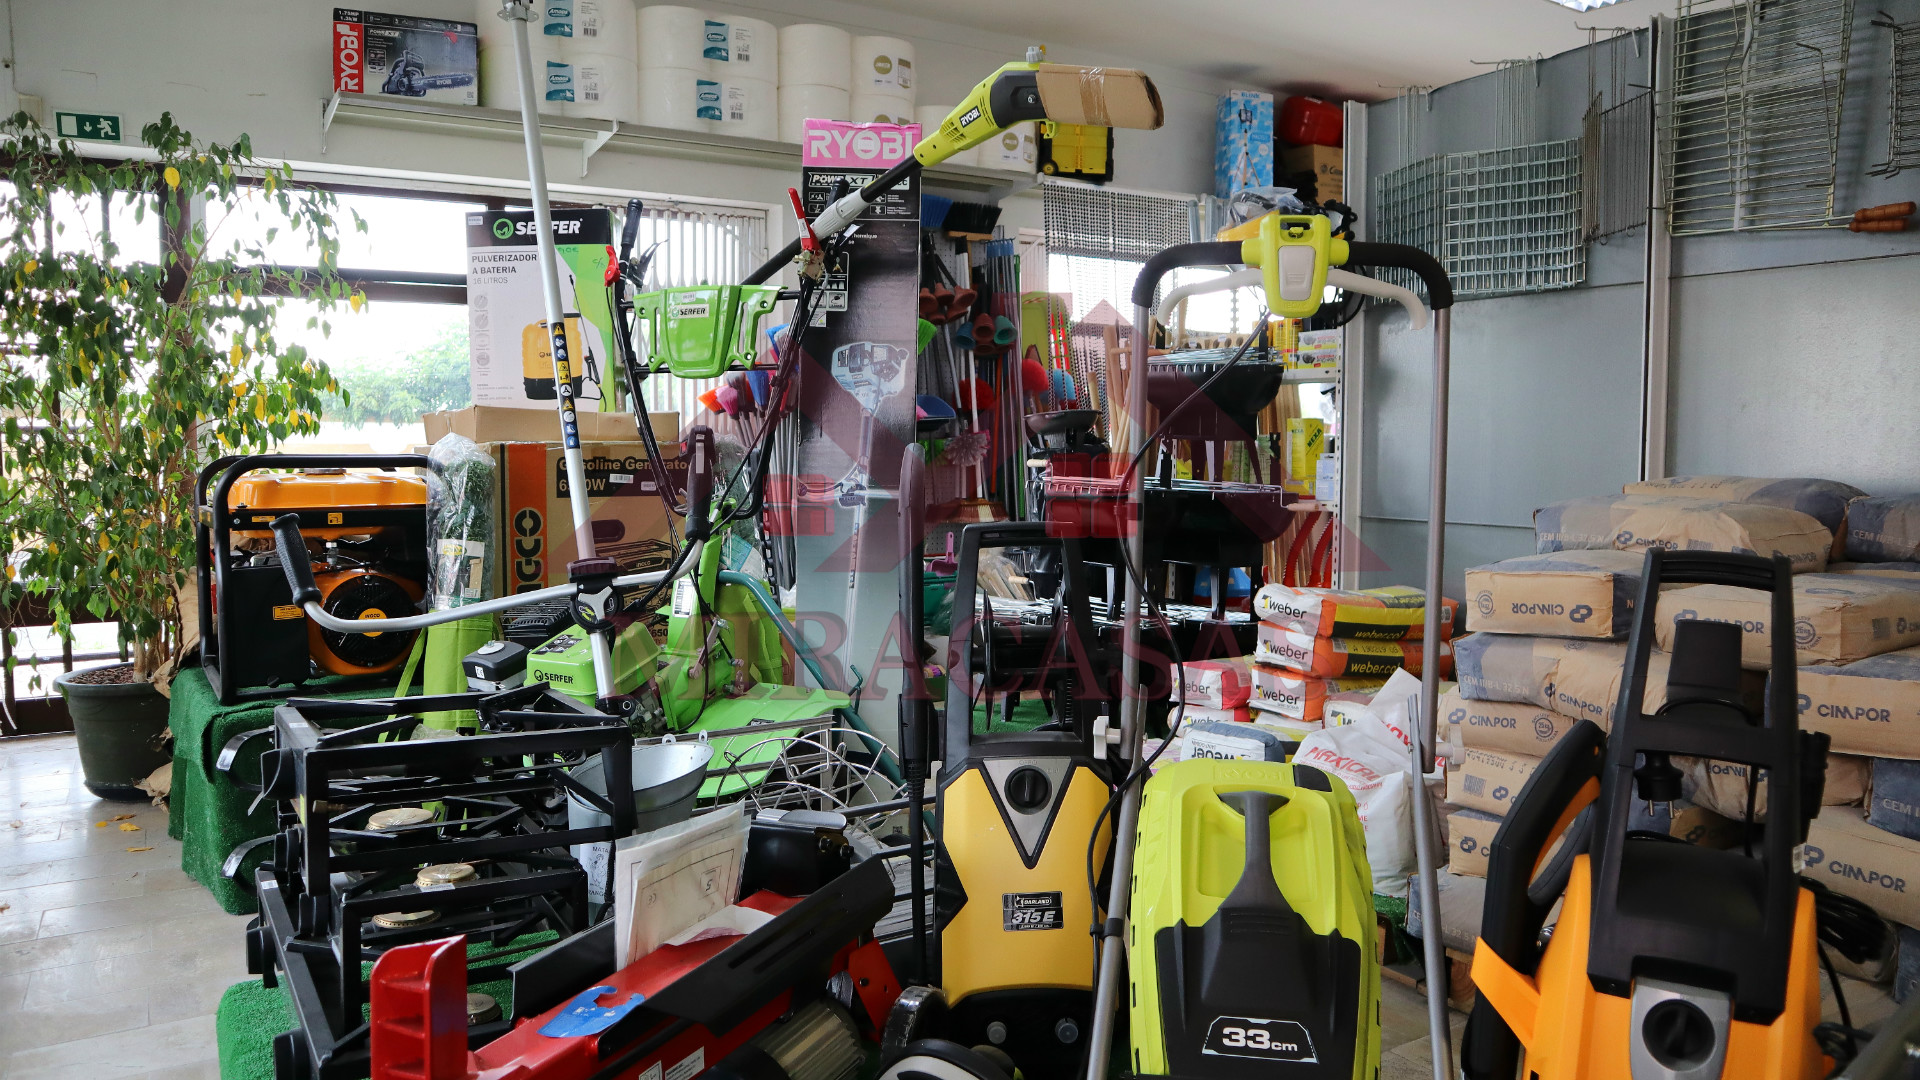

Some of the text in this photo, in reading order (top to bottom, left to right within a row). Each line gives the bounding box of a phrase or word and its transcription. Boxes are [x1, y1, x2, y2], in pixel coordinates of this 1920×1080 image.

[339, 24, 359, 91] RYOBI
[960, 109, 981, 127] RYOBI
[808, 129, 913, 160] RYOBI
[515, 219, 581, 236] SEFER
[472, 253, 537, 263] PULVERIZADOR
[480, 265, 517, 274] BATERIA
[473, 276, 508, 285] 16 LITROS
[680, 307, 706, 316] SERFER
[559, 458, 621, 471] Gsoline
[1852, 529, 1874, 541] CEM
[1636, 538, 1679, 550] CIMPOR
[1269, 600, 1308, 619] weber
[1511, 602, 1565, 616] CIMPOR
[1270, 644, 1309, 660] weber
[1351, 661, 1401, 674] weber.co
[544, 672, 574, 684] SERFER
[1463, 674, 1479, 686] CEM
[1184, 680, 1211, 694] eber
[1262, 689, 1300, 705] weber
[1559, 692, 1603, 716] CIMPOR
[1817, 703, 1891, 723] CIMPOR
[1469, 715, 1517, 729] CIMPOR
[1829, 860, 1907, 893] CIMPOR
[1012, 910, 1056, 925] 315 E
[1222, 1026, 1298, 1052] 33cm
